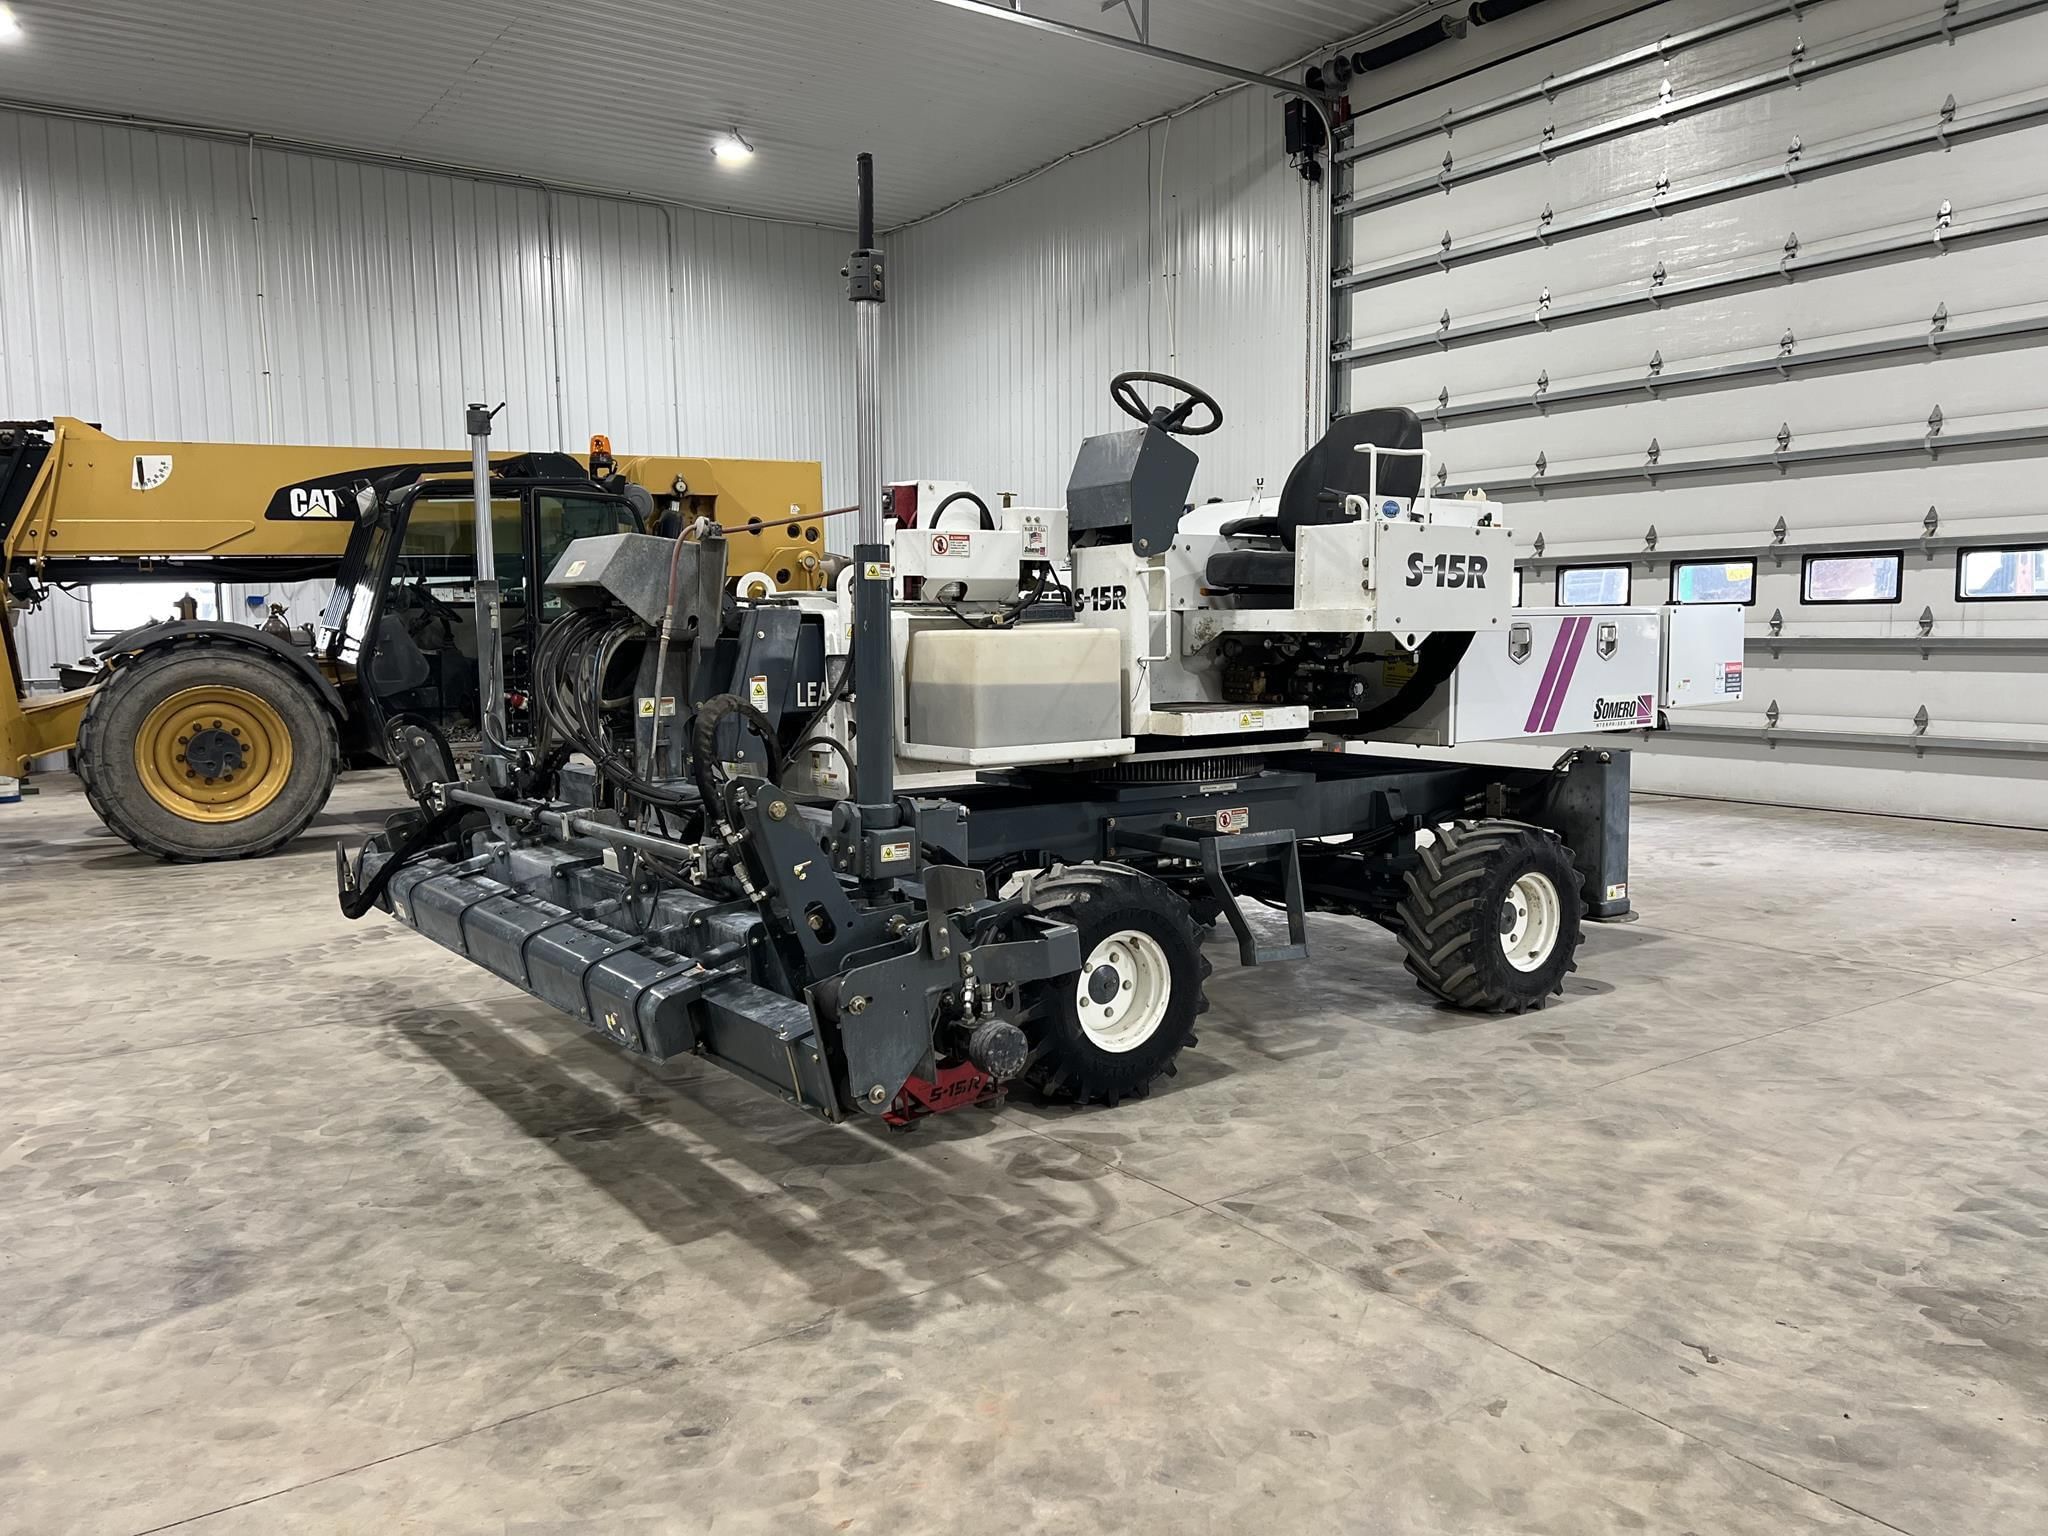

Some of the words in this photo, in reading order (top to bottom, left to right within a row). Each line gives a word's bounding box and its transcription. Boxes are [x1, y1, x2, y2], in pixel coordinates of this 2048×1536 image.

[289, 487, 338, 518] CAT
[1405, 552, 1488, 589] S-15R
[1074, 585, 1127, 612] S-15R
[1594, 698, 1636, 719] SOMERO
[929, 1075, 981, 1103] S-15R
